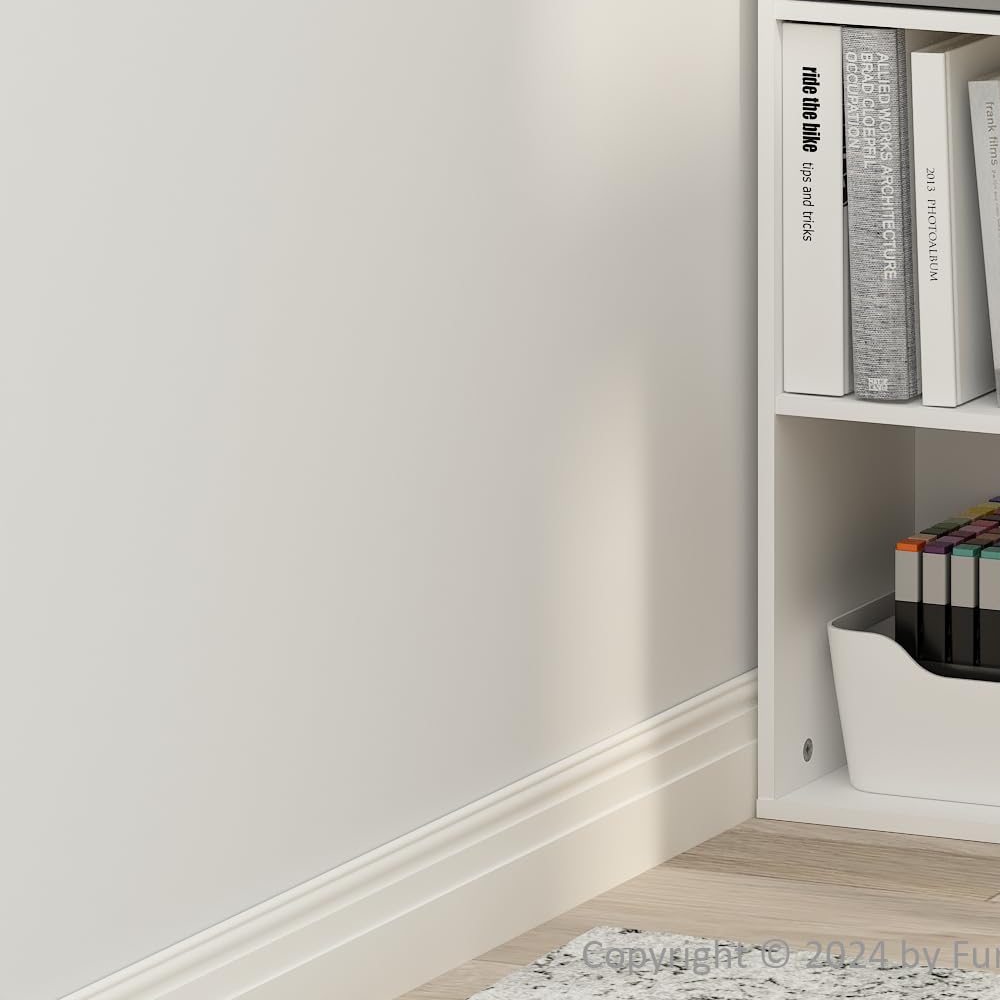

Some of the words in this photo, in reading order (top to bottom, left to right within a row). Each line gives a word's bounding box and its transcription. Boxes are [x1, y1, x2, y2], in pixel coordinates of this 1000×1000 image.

[802, 66, 820, 95] ride
[860, 53, 875, 94] BRAD
[876, 53, 891, 104] ALLIED
[802, 97, 821, 120] the
[846, 52, 860, 149] OCCUPATION
[985, 101, 997, 132] frank
[802, 123, 821, 153] bike
[862, 98, 876, 169] CLOEPFIL
[878, 107, 894, 161] WORKS
[989, 136, 999, 166] films
[800, 162, 814, 183] tips
[926, 168, 936, 192] 2013
[802, 186, 815, 207] and
[802, 211, 815, 242] tricks
[881, 165, 897, 280] ARCHITECTURE
[927, 199, 939, 282] PHOTOALBUM
